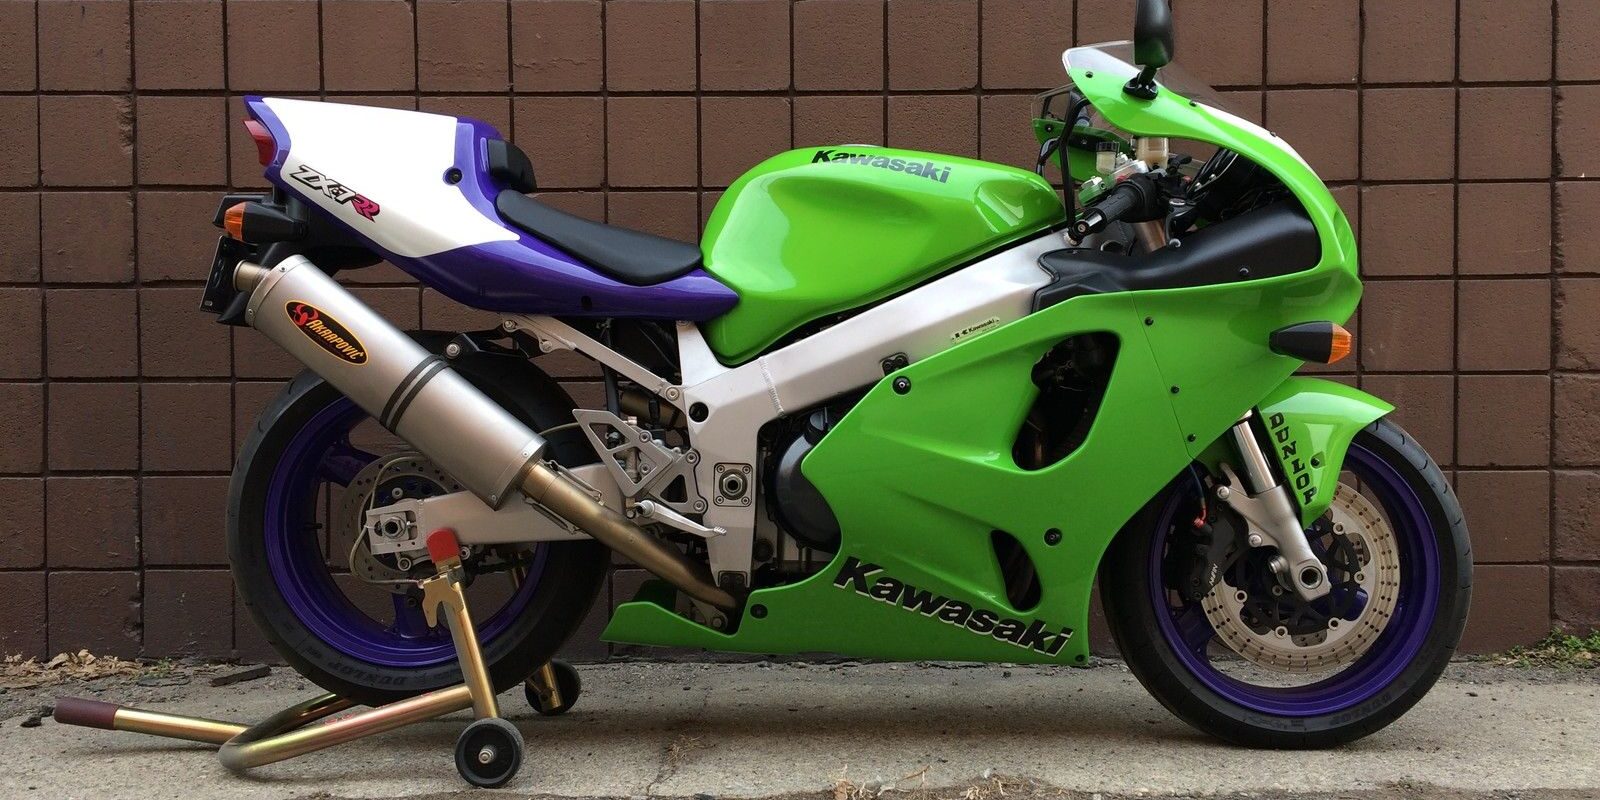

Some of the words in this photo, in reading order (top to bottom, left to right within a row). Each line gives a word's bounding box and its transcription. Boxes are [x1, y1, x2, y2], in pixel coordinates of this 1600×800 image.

[811, 150, 952, 183] Kawasaki
[1269, 412, 1318, 505] DUNLOP
[833, 556, 1074, 657] Kawasaki
[326, 661, 408, 687] DUNLOP
